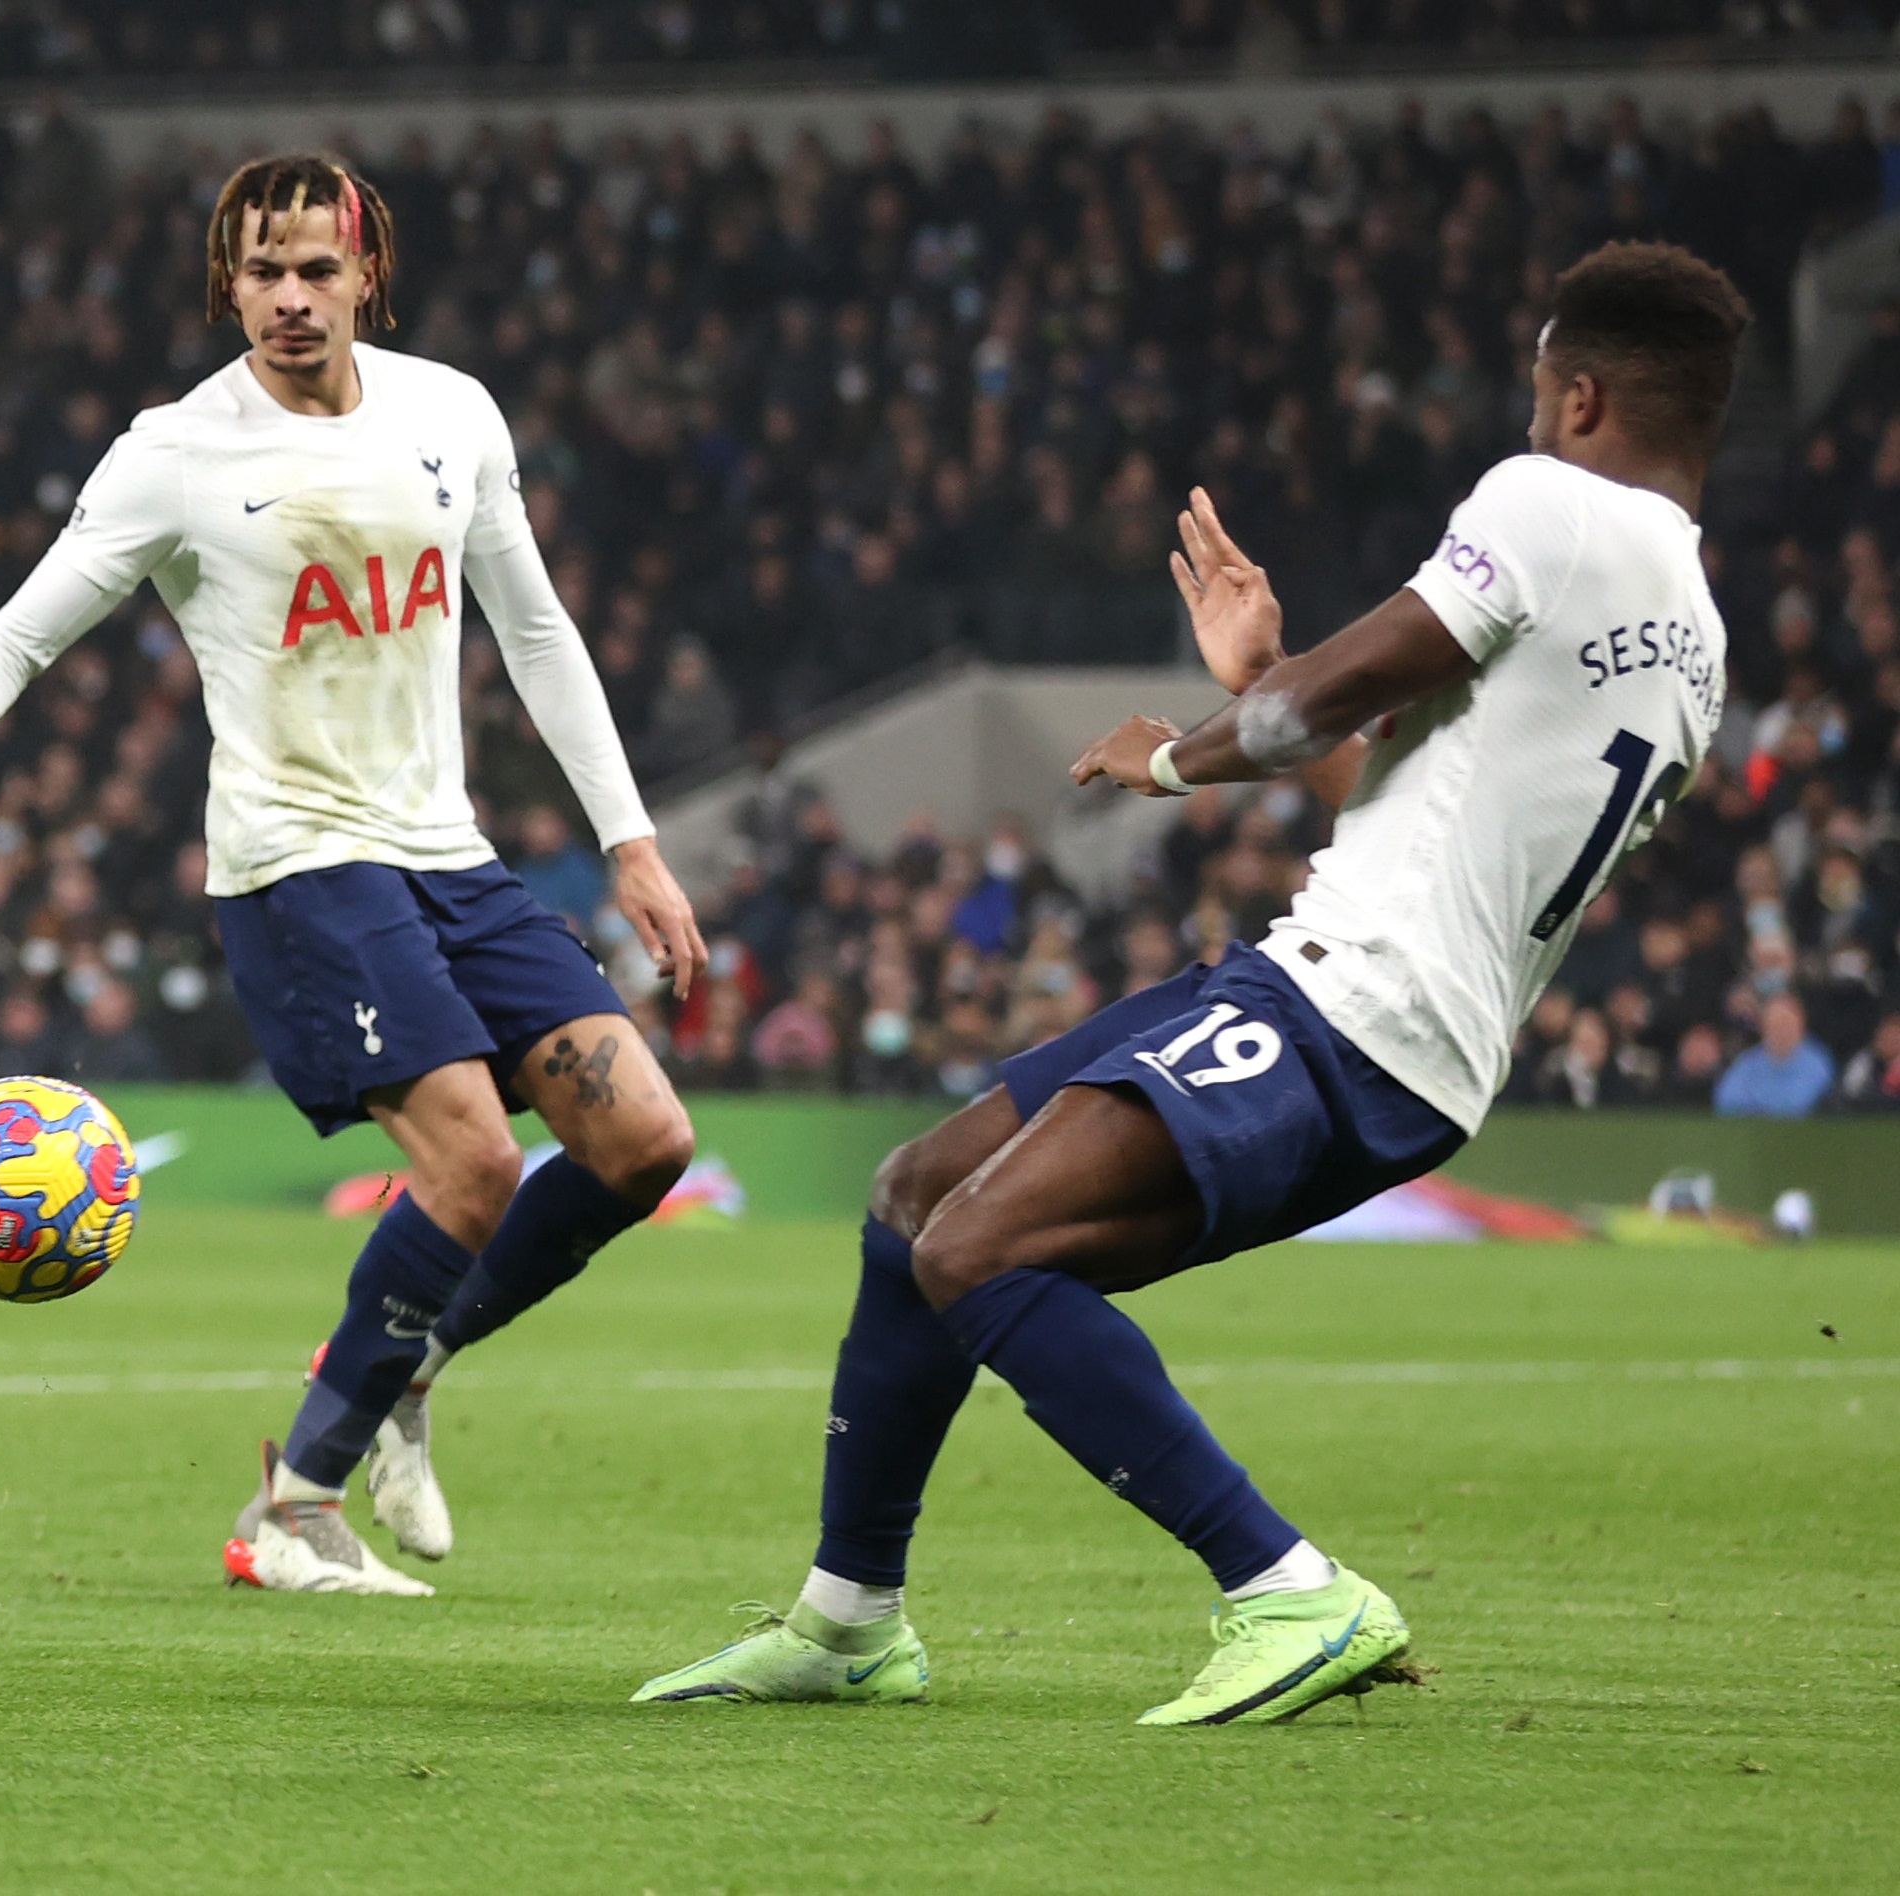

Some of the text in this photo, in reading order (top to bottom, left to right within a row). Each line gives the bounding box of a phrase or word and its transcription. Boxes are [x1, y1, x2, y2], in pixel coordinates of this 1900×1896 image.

[281, 546, 450, 648] AIA
[1442, 533, 1495, 592] nch
[1133, 1002, 1282, 1098] 19
